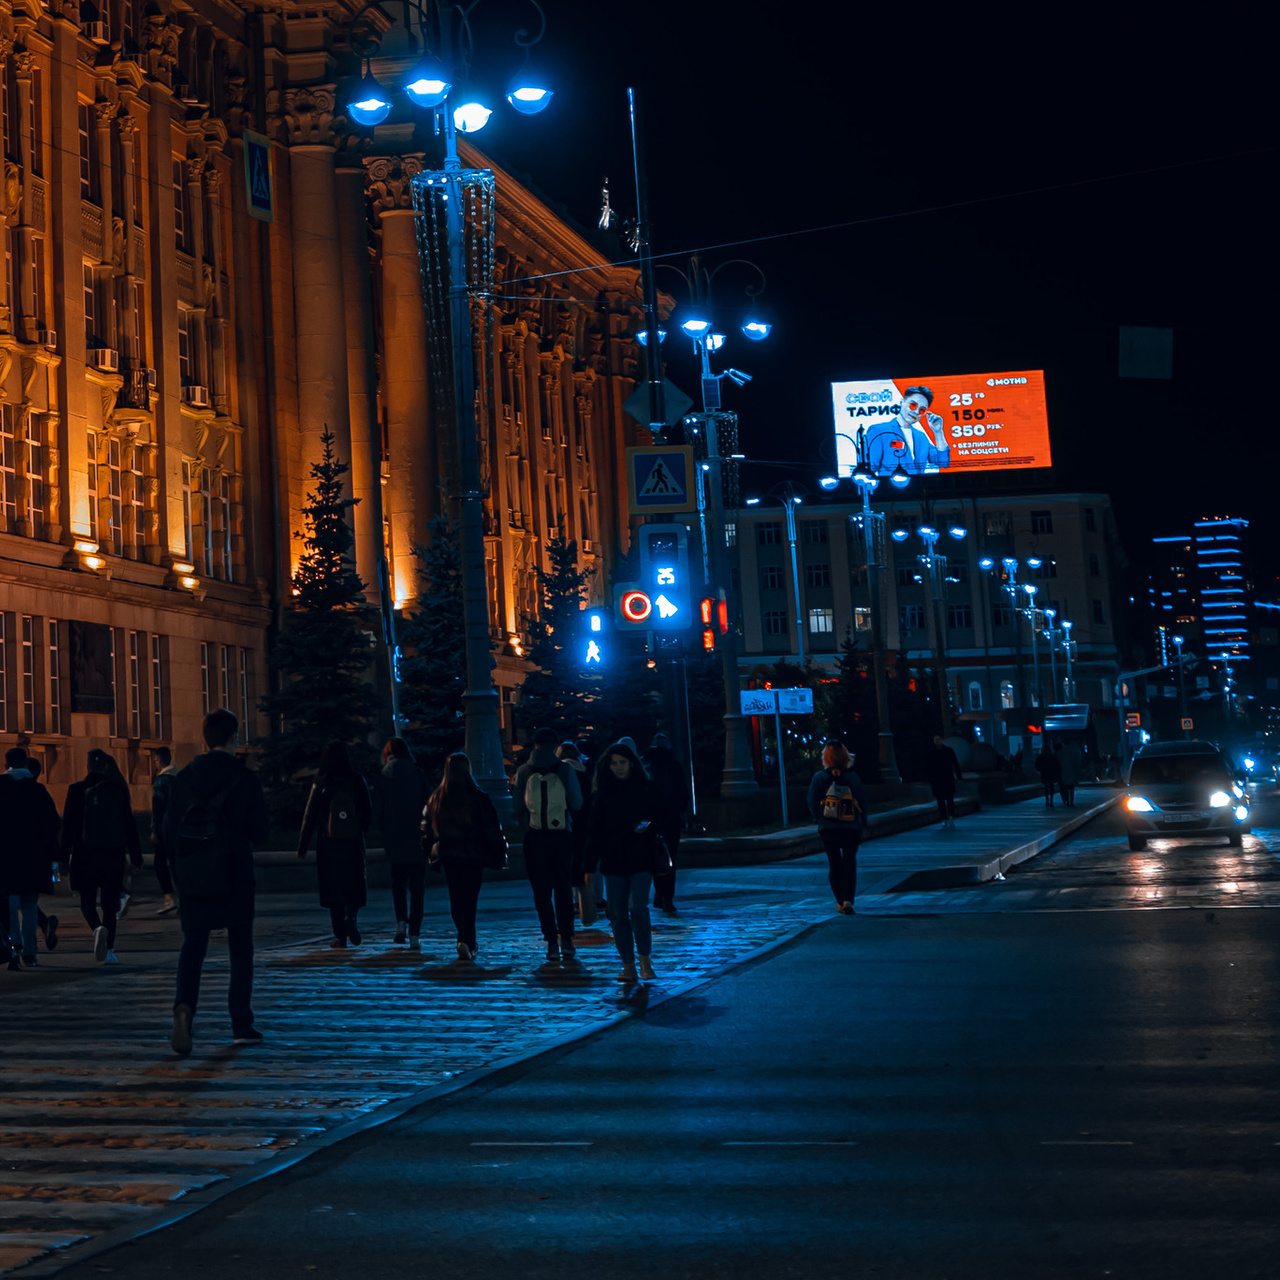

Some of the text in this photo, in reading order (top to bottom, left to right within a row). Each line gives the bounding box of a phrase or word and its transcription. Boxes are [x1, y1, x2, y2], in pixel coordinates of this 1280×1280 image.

[995, 377, 1028, 386] МОТИВ
[845, 388, 892, 403] СВОЙ
[949, 392, 974, 407] 25
[846, 404, 901, 417] ТАРИФ
[951, 409, 985, 421] 150
[951, 424, 986, 438] 350
[970, 447, 1009, 455] СОЦСЕТИ
